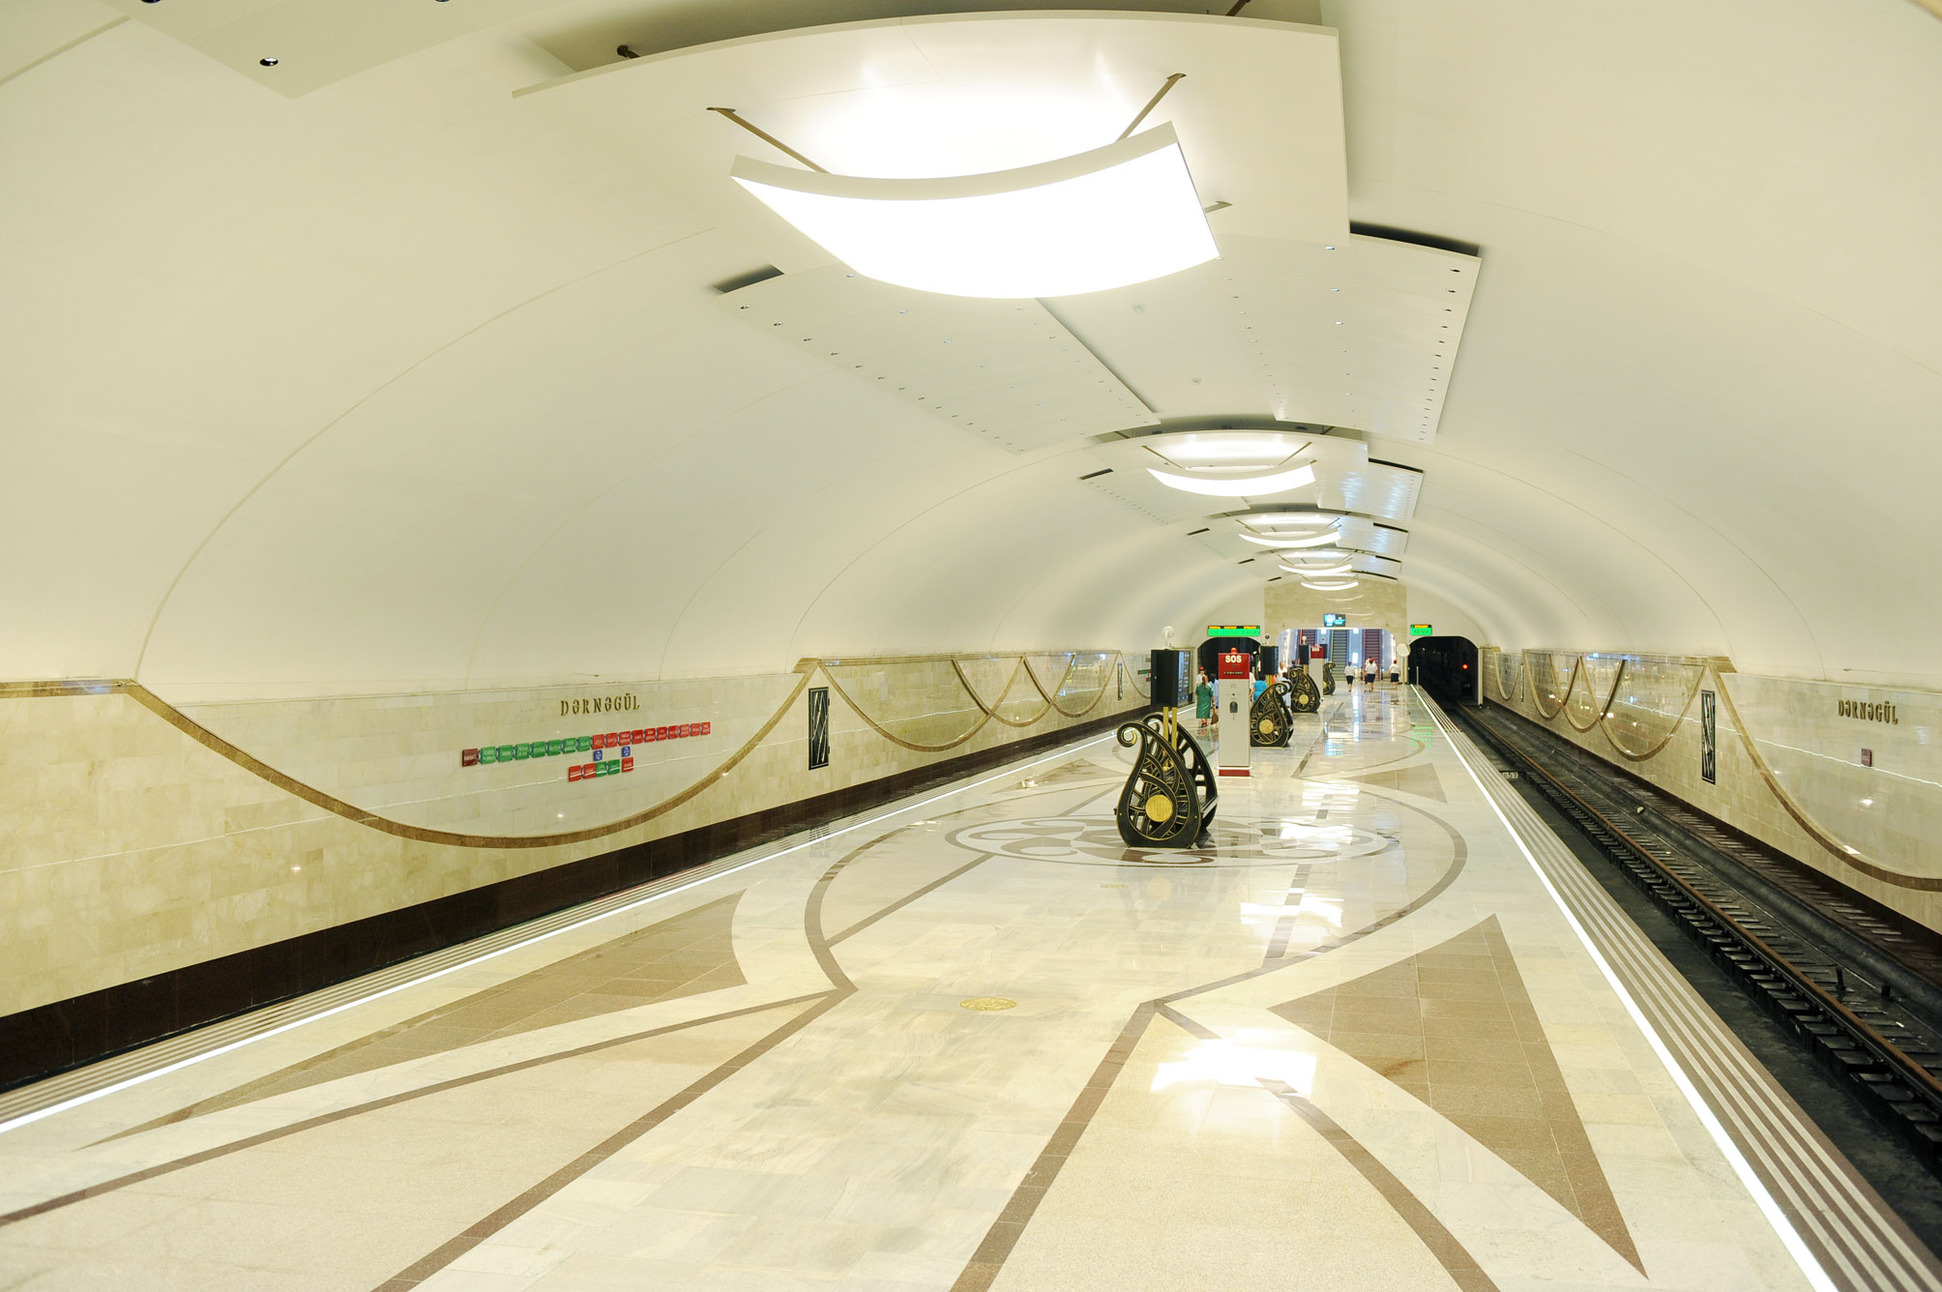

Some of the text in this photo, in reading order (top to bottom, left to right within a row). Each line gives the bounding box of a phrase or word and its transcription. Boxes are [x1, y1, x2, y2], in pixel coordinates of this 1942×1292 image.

[1225, 654, 1242, 663] SOS
[560, 692, 640, 716] DƏRNƏGÜL
[1838, 700, 1898, 724] DƏRNƏGÜL
